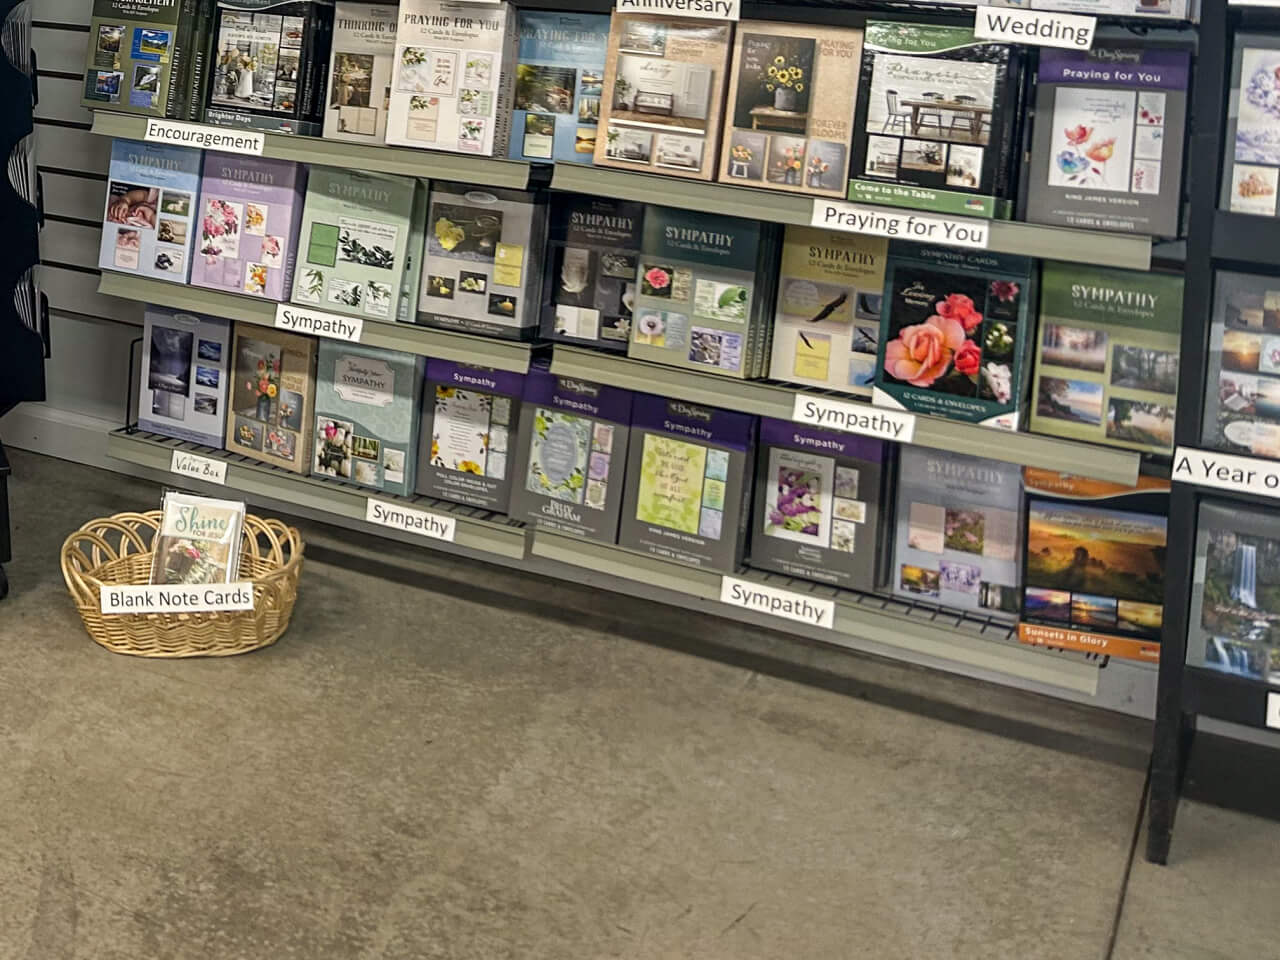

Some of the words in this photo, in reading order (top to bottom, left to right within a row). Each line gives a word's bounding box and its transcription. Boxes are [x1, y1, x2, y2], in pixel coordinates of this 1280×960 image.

[403, 12, 451, 28] PRAYING
[454, 15, 474, 30] FOR
[477, 17, 500, 32] YOU
[987, 14, 1092, 46] Wedding
[1063, 68, 1111, 81] Praying
[1114, 70, 1133, 80] for
[1137, 72, 1161, 83] You
[208, 110, 234, 122] Brighter
[235, 114, 252, 124] Days
[147, 121, 260, 152] Encouragement
[128, 153, 181, 170] SYMPATHY
[221, 167, 275, 184] SYMPATHY
[328, 181, 391, 203] SYMPATHY
[855, 182, 880, 194] Come
[881, 186, 891, 195] to
[893, 187, 910, 197] the
[911, 188, 937, 200] Table
[571, 209, 634, 231] SYMPATHY
[824, 205, 900, 235] Praying
[904, 215, 937, 237] for
[942, 219, 985, 246] You
[665, 225, 735, 248] SYMPATHY
[808, 245, 877, 267] SYMPATHY
[920, 248, 965, 262] SYMPATHY
[967, 254, 999, 266] CARDS
[1070, 283, 1160, 310] SYMPATHY
[282, 310, 358, 338] Sympathy
[341, 373, 386, 390] SYMPATHY
[453, 372, 498, 389] Sympathy
[553, 394, 599, 414] Sympathy
[663, 419, 713, 439] Sympathy
[804, 401, 905, 436] Sympathy
[792, 432, 846, 452] Sympathy
[176, 456, 200, 476] Value
[203, 461, 220, 479] Box
[926, 457, 1006, 485] SYMPATHY
[1175, 456, 1193, 475] A
[1200, 458, 1257, 486] Year
[175, 505, 229, 533] Shine
[373, 504, 450, 537] Sympathy
[110, 591, 155, 609] Blank
[159, 590, 199, 607] Note
[203, 588, 251, 606] Cards
[730, 583, 826, 622] Sympathy
[1024, 626, 1066, 641] Sunsets
[1066, 632, 1078, 642] in
[1080, 634, 1109, 648] Glory
